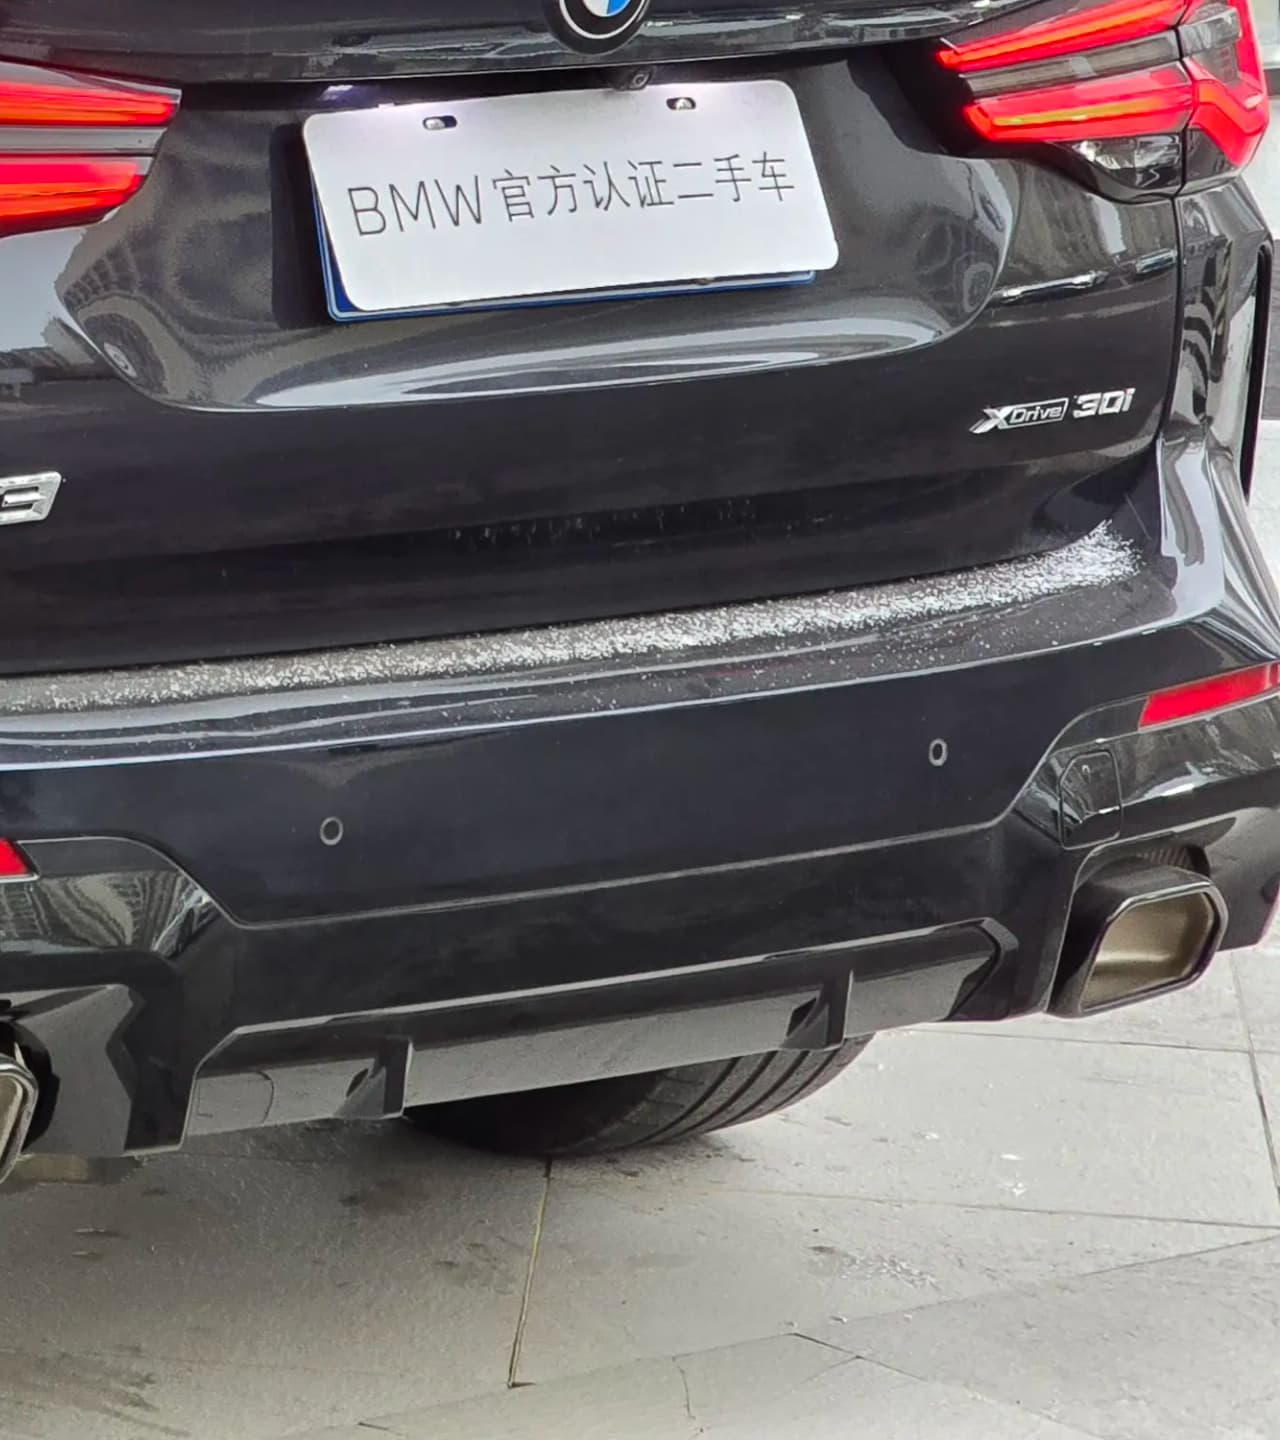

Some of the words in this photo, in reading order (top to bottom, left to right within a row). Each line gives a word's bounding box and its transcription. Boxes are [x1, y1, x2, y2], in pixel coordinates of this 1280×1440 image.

[347, 173, 483, 237] BMW
[492, 151, 795, 223] 官方认证二手车
